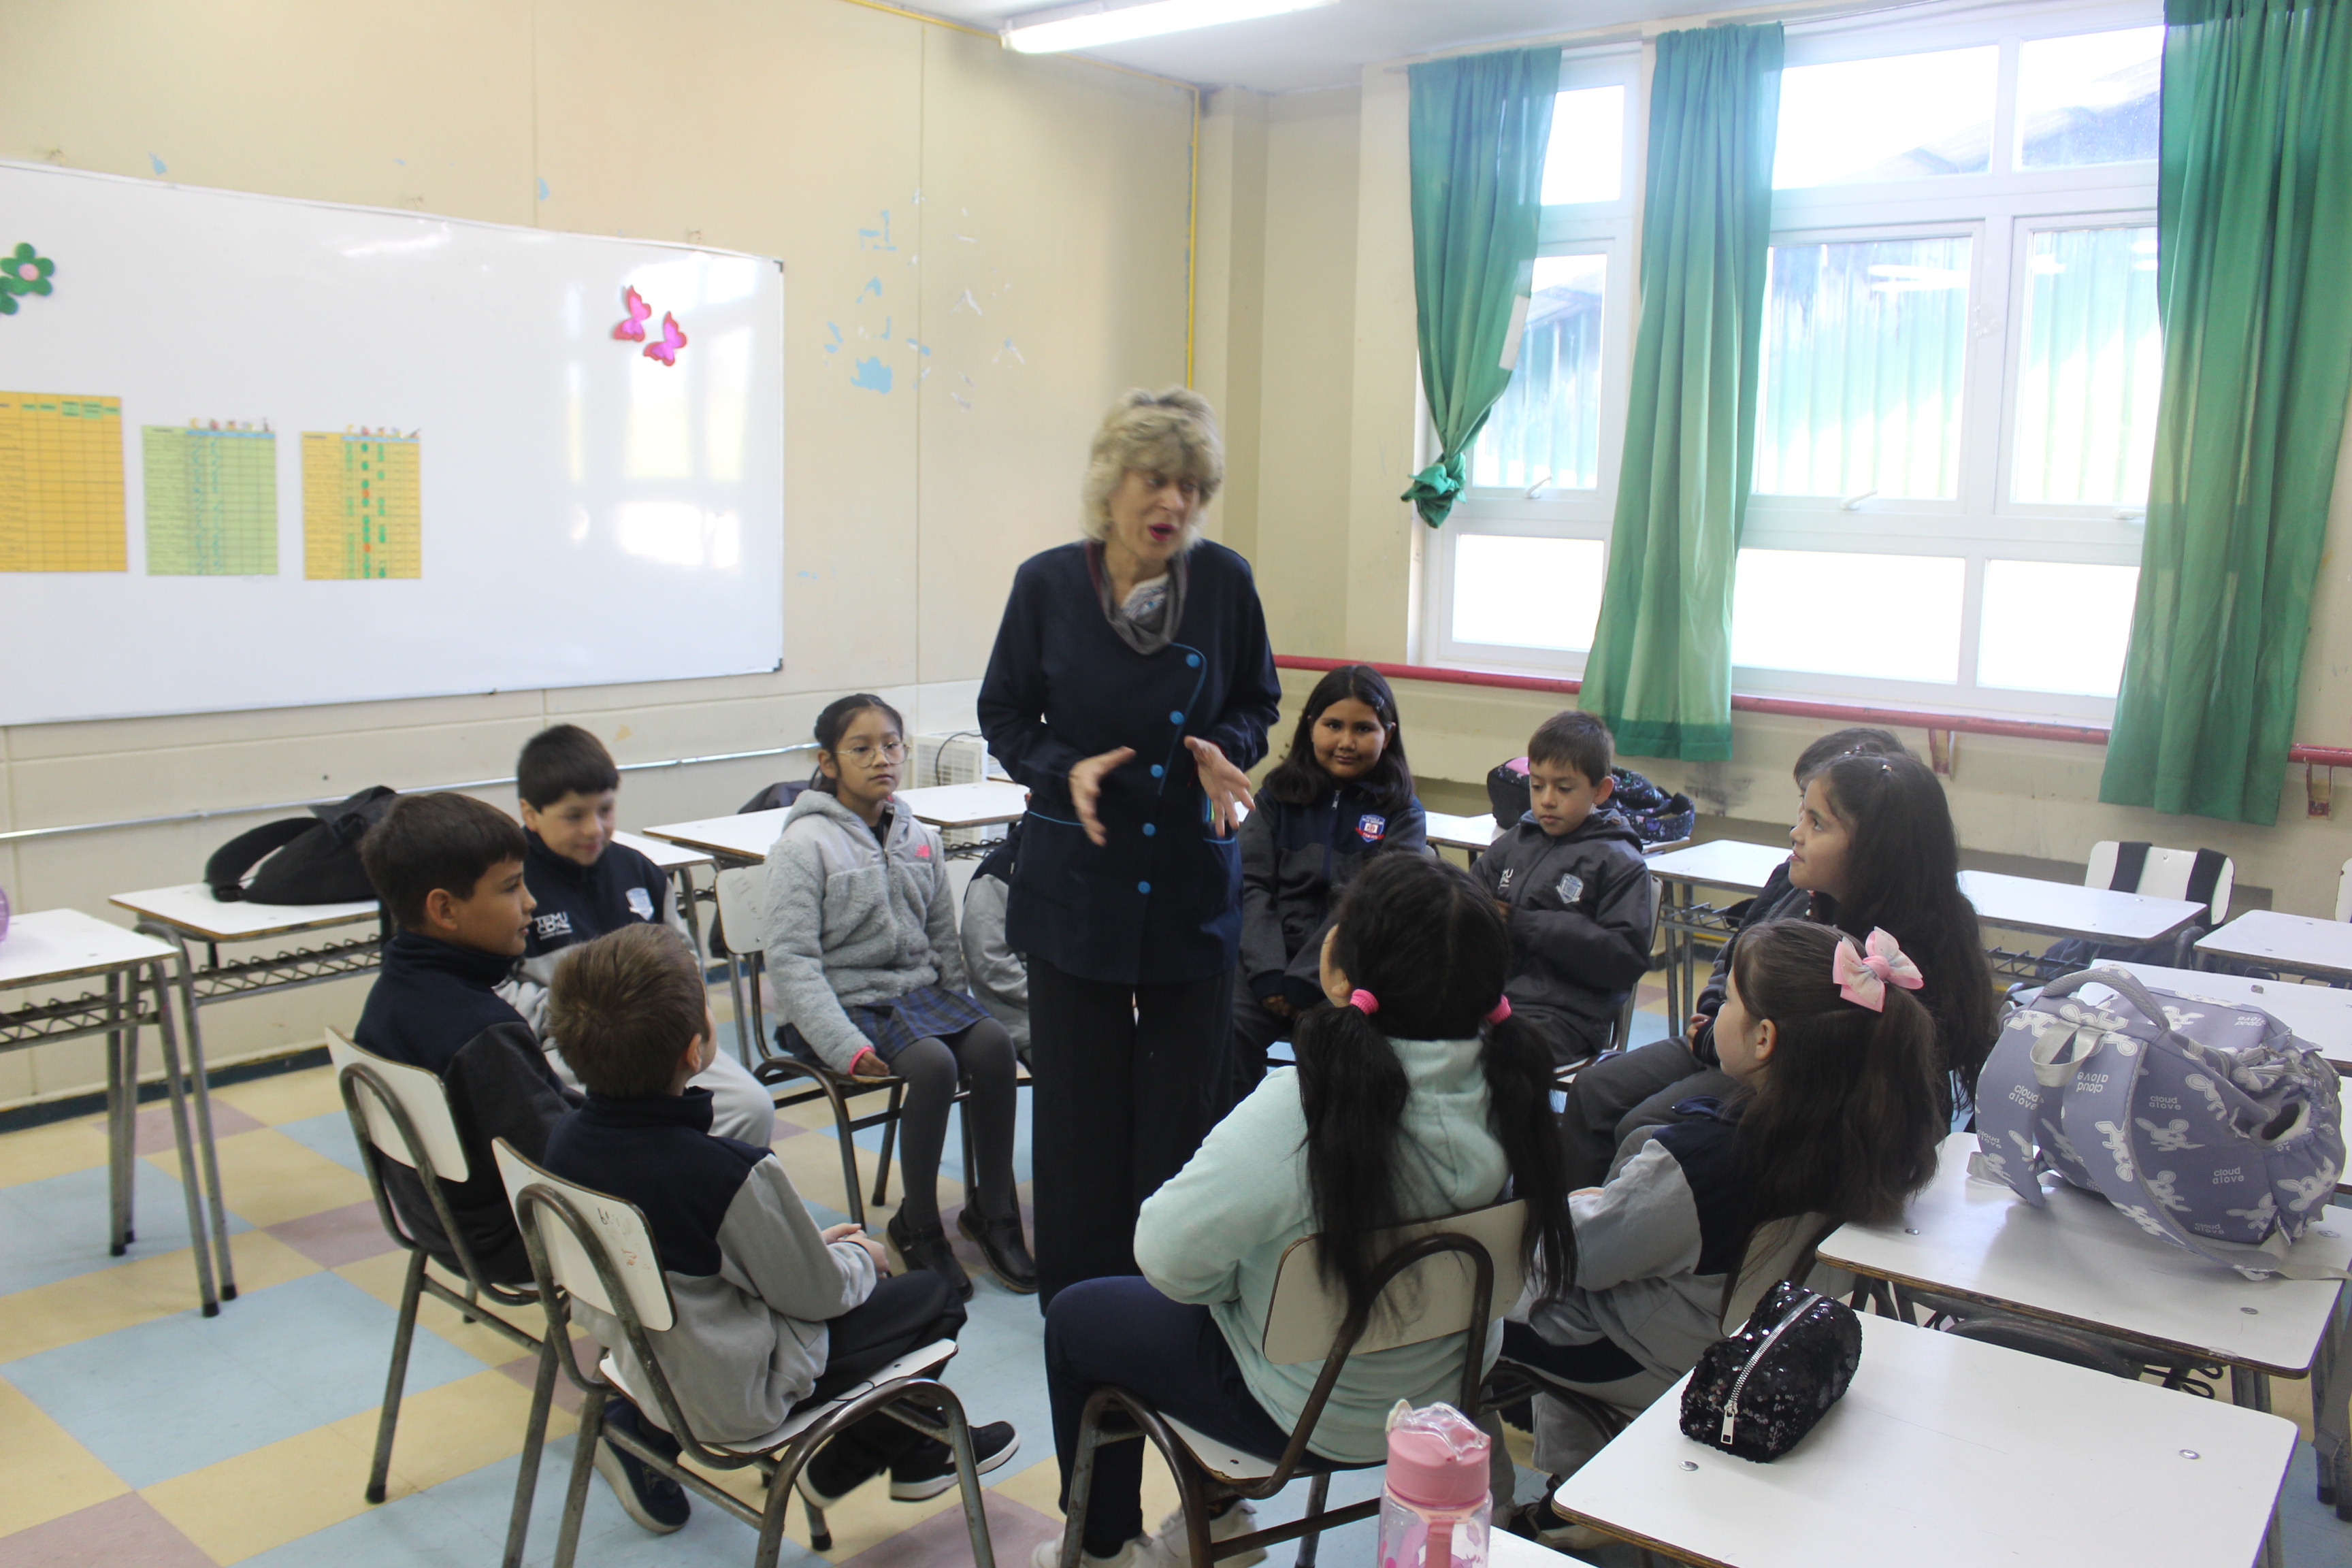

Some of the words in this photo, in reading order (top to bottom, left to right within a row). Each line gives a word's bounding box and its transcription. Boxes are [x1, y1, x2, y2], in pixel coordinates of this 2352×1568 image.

[2077, 1071, 2109, 1083] alove
[2014, 1084, 2040, 1102] cloud
[2076, 1082, 2103, 1094] cloud
[2008, 1092, 2038, 1111] alove
[2150, 1095, 2178, 1103] cloud
[2149, 1102, 2181, 1110] alove
[1977, 1129, 1999, 1143] cloud
[2214, 1166, 2241, 1177] cloud
[2212, 1175, 2244, 1184] alove
[2194, 1226, 2225, 1235] alove
